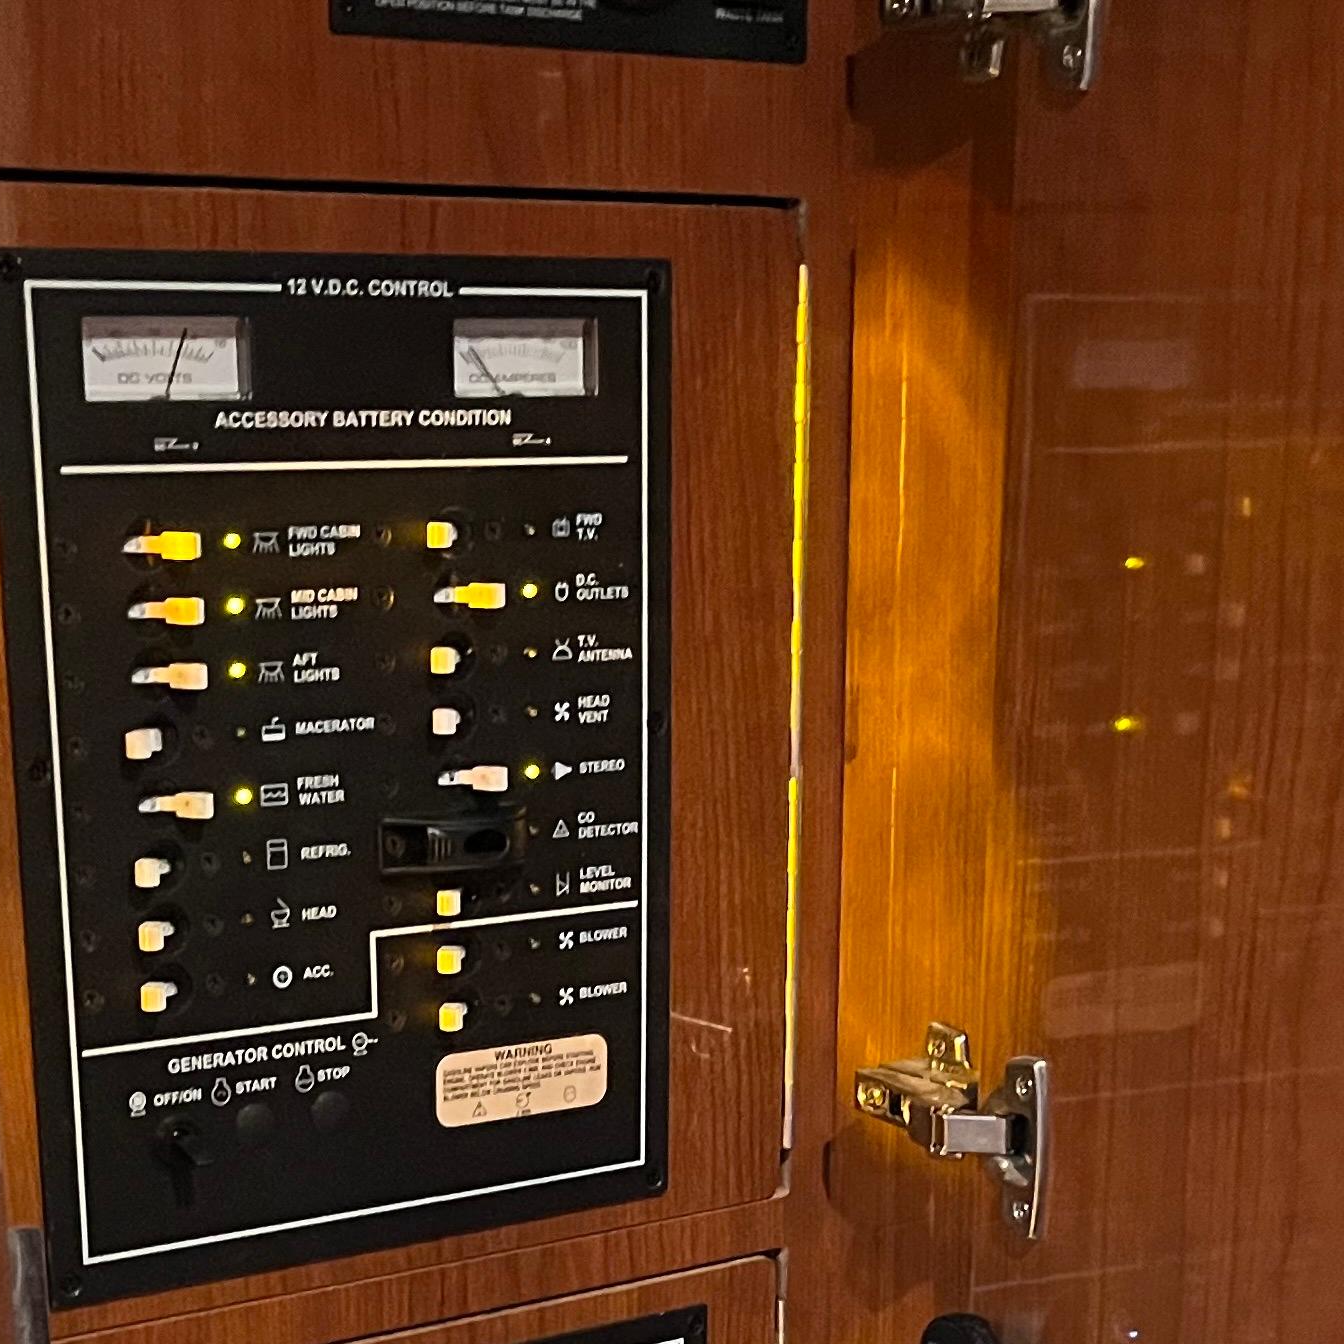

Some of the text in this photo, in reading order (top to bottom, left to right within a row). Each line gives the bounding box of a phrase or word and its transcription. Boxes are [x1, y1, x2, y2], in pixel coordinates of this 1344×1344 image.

[286, 278, 454, 298] 12 V.D.C. CONTROL
[215, 408, 512, 429] ACCESSORY BATTERY CONDITION
[576, 512, 603, 527] FWD
[288, 524, 361, 540] FWD CABIN
[288, 542, 336, 557] LIGHTS
[290, 587, 358, 604] MID CABIN
[576, 585, 629, 601] OUTLETS
[291, 605, 338, 620] LIGHTS
[292, 652, 318, 667] AFT
[576, 648, 633, 663] ANTENNA
[293, 667, 340, 683] LIGHTS
[577, 695, 610, 710] HEAD
[577, 709, 609, 724] VENT
[295, 717, 375, 735] MACERATOR
[578, 758, 626, 775] STEREO
[297, 774, 340, 790] FRESH
[299, 790, 345, 806] WATER
[577, 811, 596, 825] CO
[578, 821, 639, 839] DETECTOR
[300, 843, 351, 861] REFRIG.
[579, 864, 615, 880] LEVEL
[579, 877, 632, 894] MONITOR
[301, 905, 337, 921] HEAD
[579, 926, 628, 944] BLOWER
[303, 964, 334, 980] ACC.
[579, 981, 627, 1000] BLOWER
[167, 1035, 346, 1074] GENERATOR CONTROL
[494, 1043, 553, 1061] WARNING
[317, 1065, 351, 1083] STOP
[235, 1076, 277, 1095] START
[153, 1087, 202, 1107] OFF/ON
